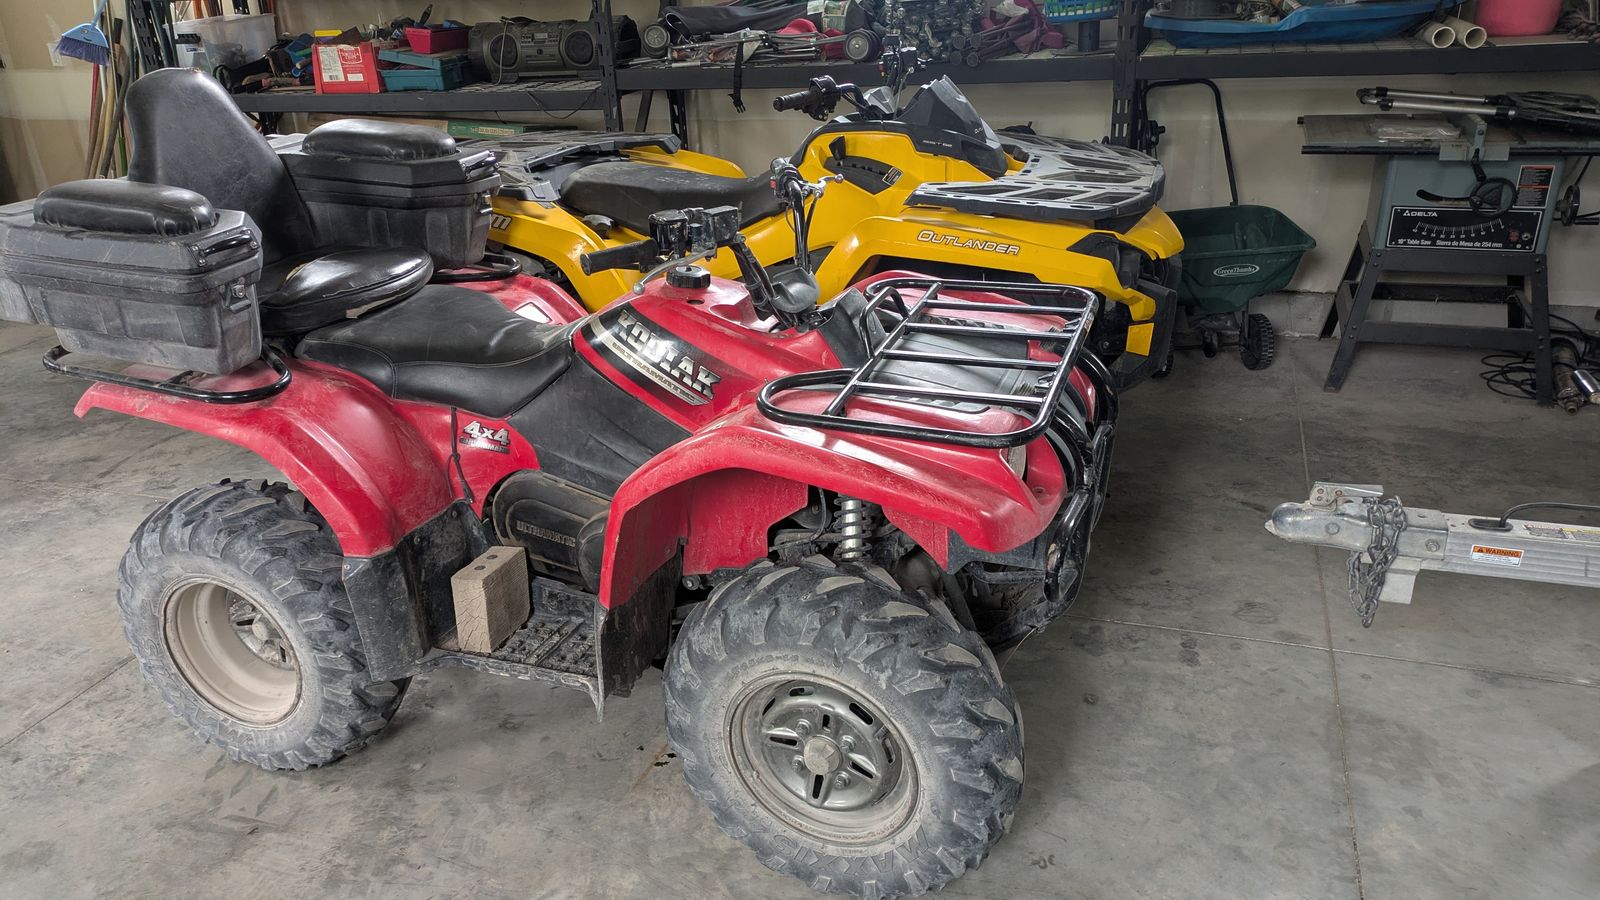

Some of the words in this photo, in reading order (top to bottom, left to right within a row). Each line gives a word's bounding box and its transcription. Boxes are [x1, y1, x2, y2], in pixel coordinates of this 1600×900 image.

[917, 230, 1021, 256] OUTLANDER
[617, 308, 721, 400] KODIAK
[463, 420, 511, 447] 4x4
[515, 519, 576, 548] ULTRAMATIC
[1486, 547, 1520, 557] WARNING
[773, 825, 929, 875] MAXXIS
